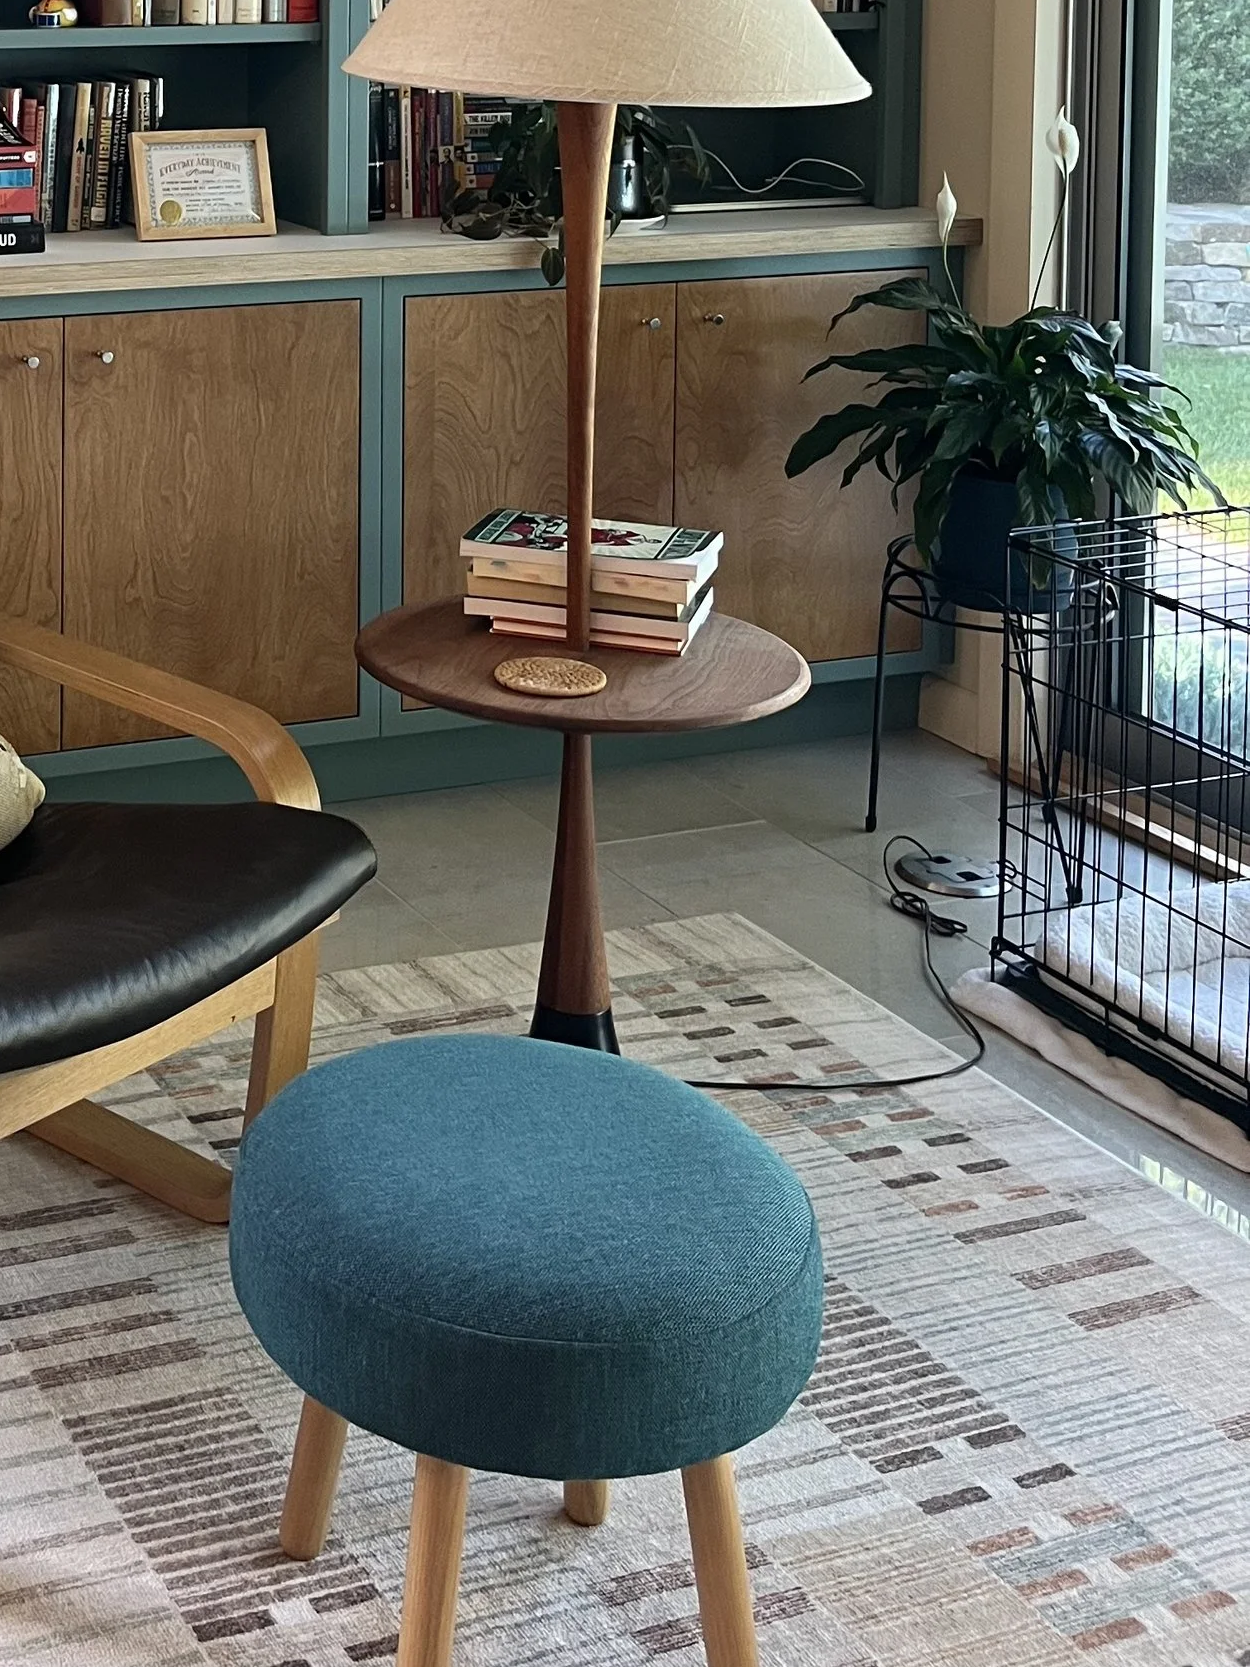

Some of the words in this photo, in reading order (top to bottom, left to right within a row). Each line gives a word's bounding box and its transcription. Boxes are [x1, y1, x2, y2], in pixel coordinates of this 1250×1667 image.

[469, 115, 479, 123] THE
[98, 118, 113, 158] RAVEN
[97, 159, 109, 174] IN
